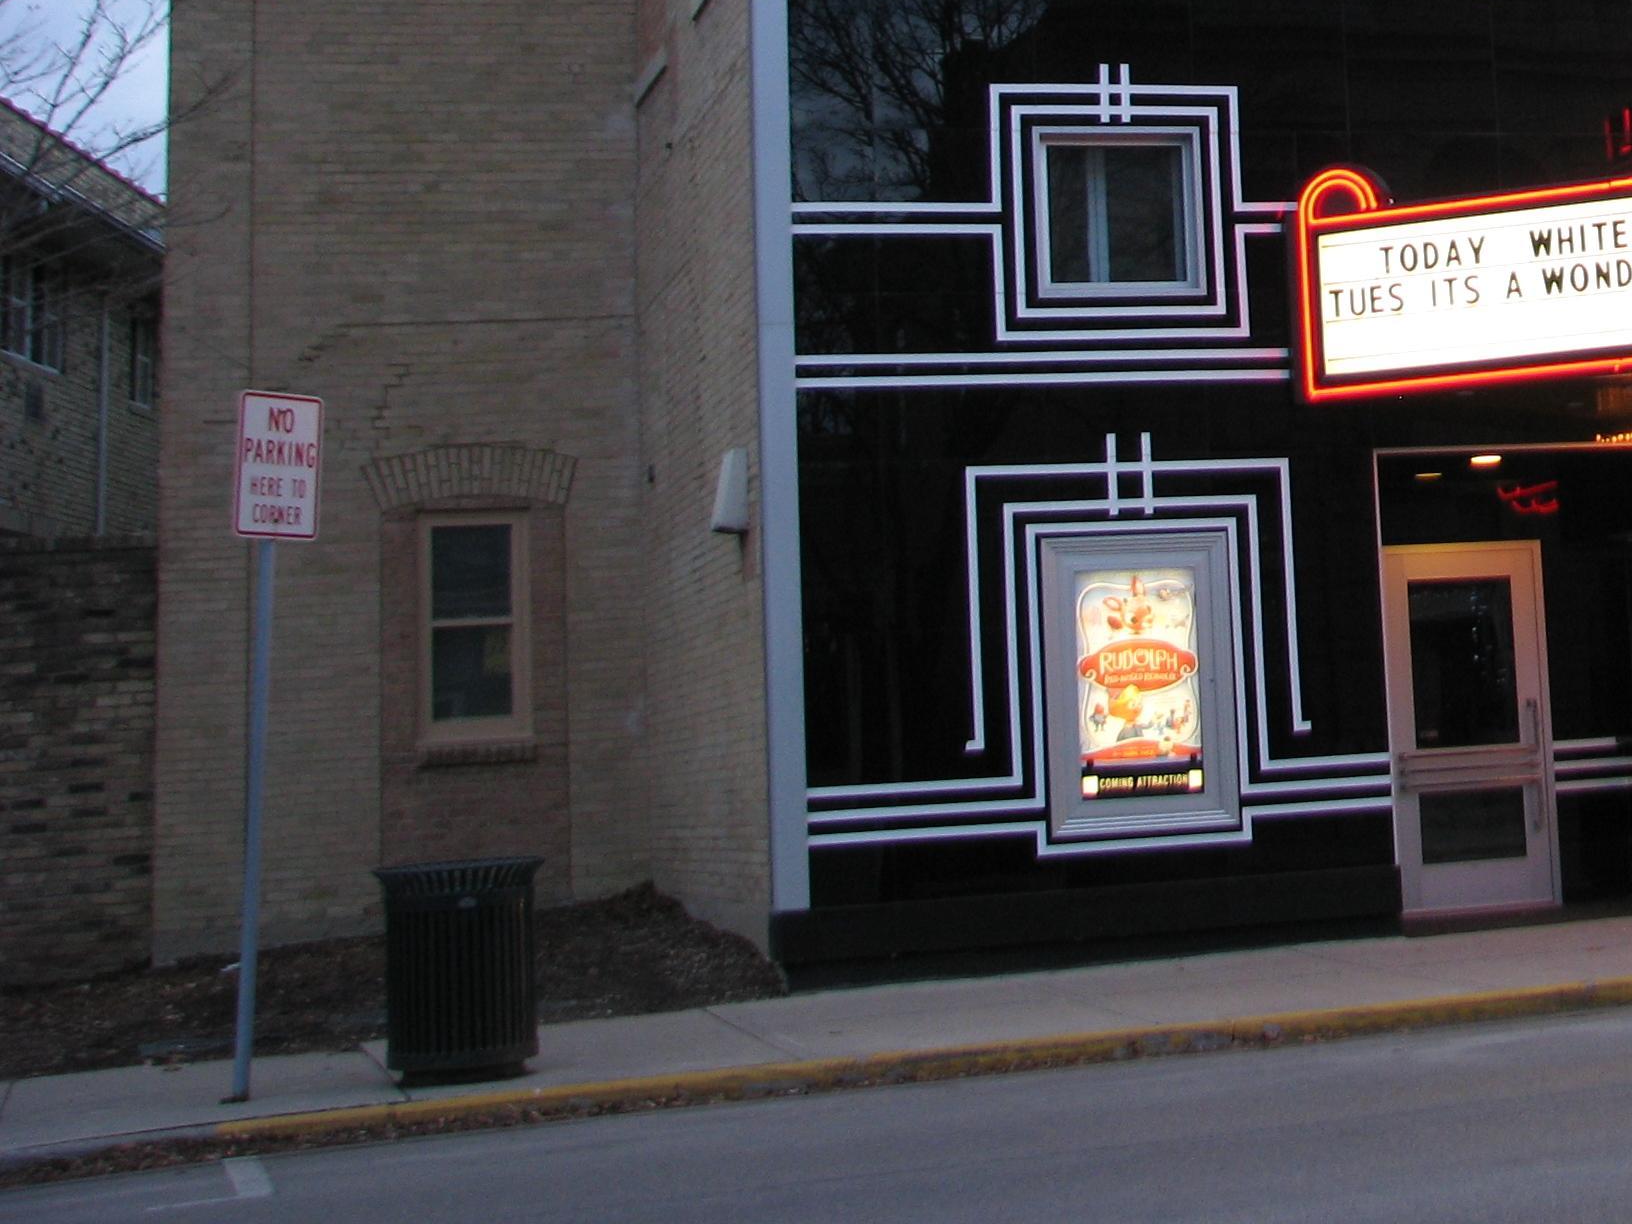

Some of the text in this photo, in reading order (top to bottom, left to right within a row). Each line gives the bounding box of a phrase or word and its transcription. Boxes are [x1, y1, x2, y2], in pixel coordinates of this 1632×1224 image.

[1379, 235, 1486, 275] TODAY
[1529, 220, 1628, 258] WHITE
[1329, 281, 1404, 318] TUES
[1430, 275, 1480, 308] ITS
[1507, 272, 1523, 300] A
[269, 407, 295, 433] NO
[244, 438, 318, 468] PARKING
[251, 475, 307, 499] HERE TO
[252, 504, 303, 525] CORNER
[1099, 648, 1178, 675] RUDOLPH
[1100, 773, 1189, 790] COMING ATTRACTION
